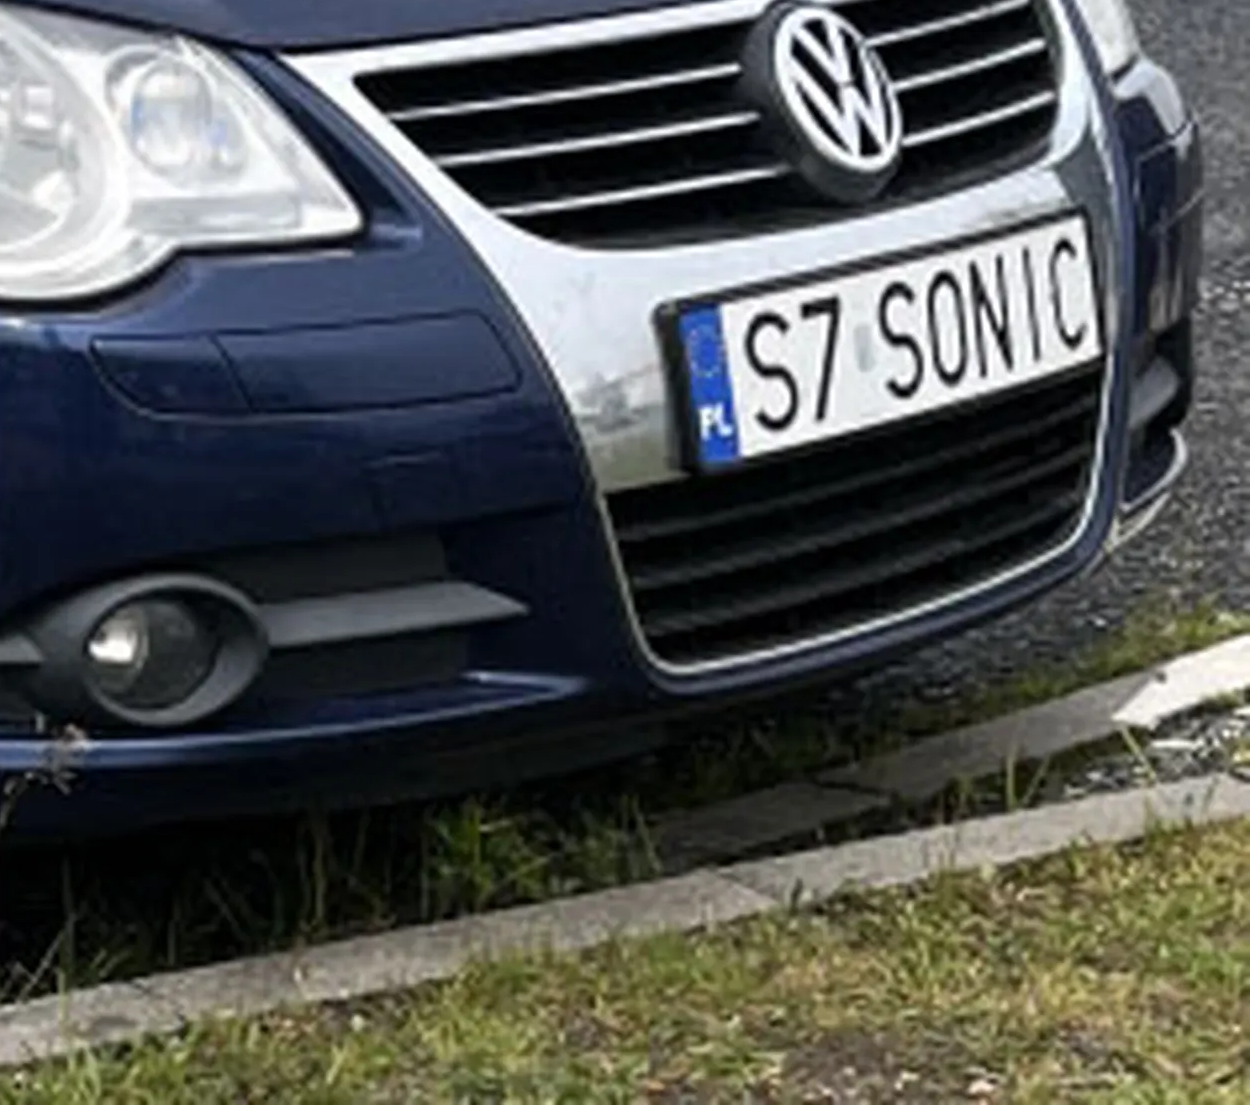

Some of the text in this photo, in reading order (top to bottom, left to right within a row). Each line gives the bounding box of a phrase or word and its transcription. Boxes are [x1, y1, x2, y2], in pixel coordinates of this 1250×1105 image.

[743, 237, 1088, 433] S7 SONIC
[700, 402, 732, 441] PL
